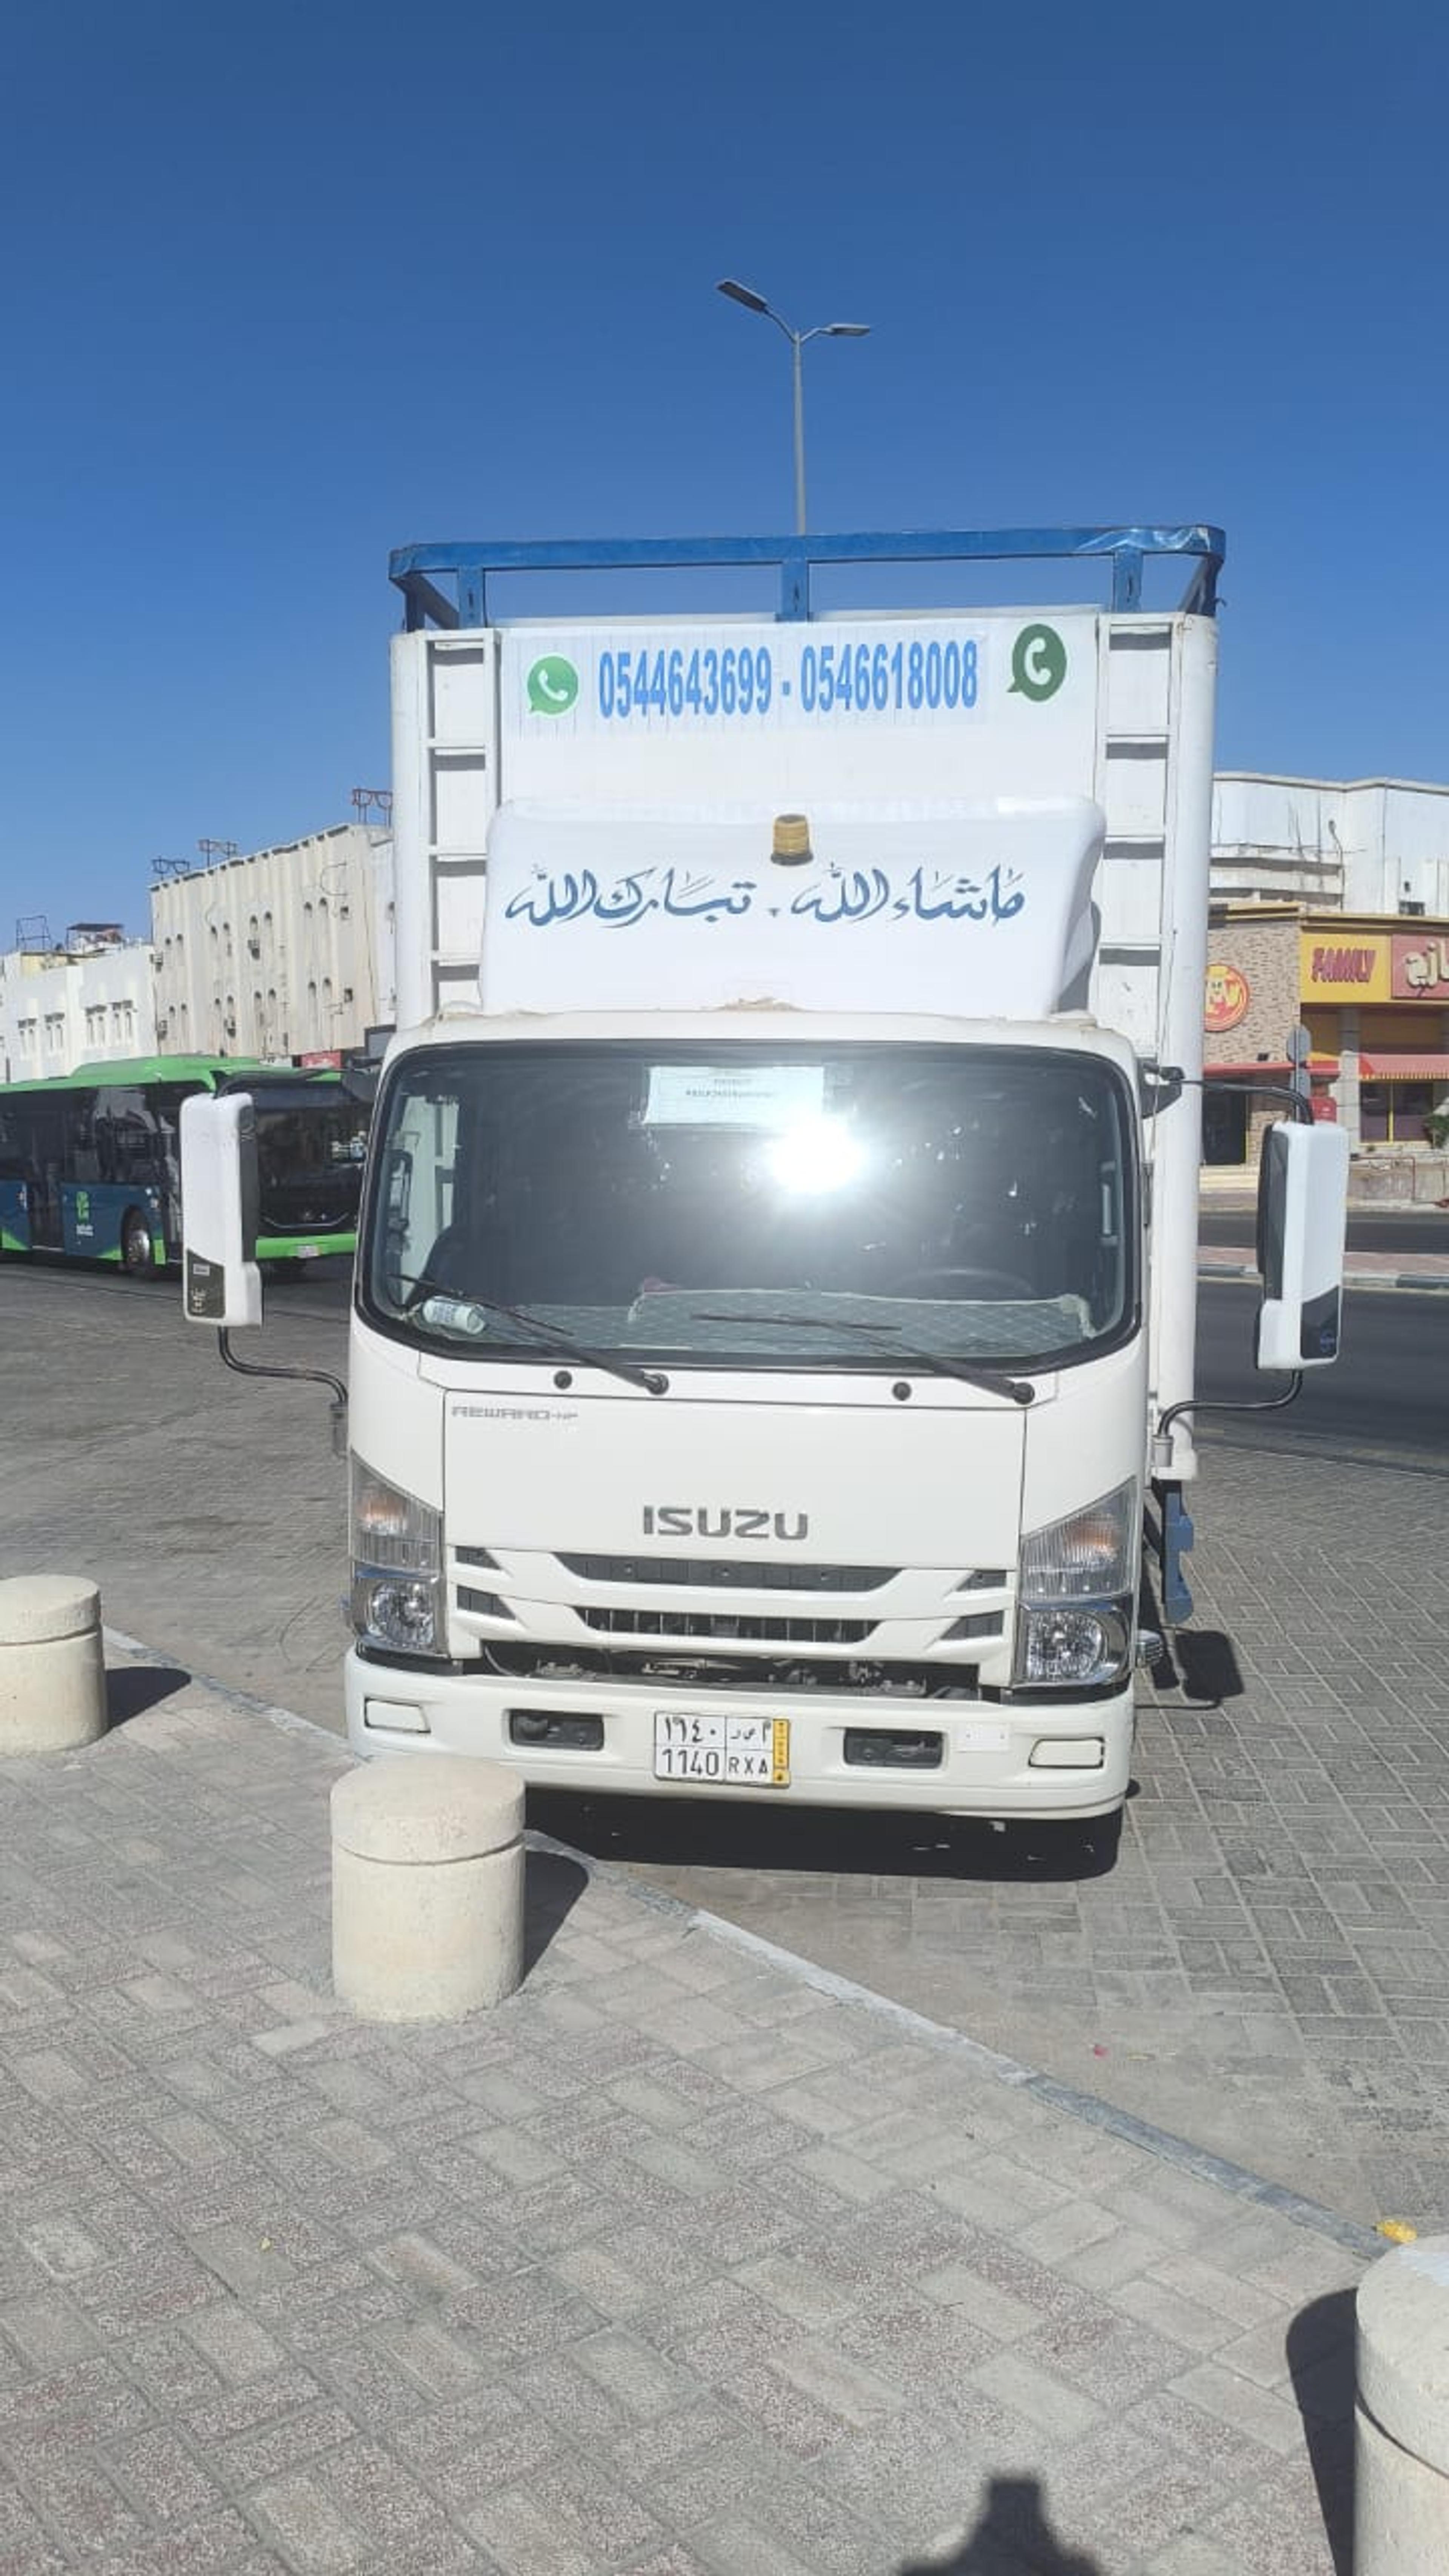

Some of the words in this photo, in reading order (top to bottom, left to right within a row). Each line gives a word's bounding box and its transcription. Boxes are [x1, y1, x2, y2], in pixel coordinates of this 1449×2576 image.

[600, 646, 771, 718] 0544643699
[801, 640, 977, 712] 0546618008
[505, 864, 597, 926] الله
[594, 867, 757, 929] تبارك
[791, 858, 889, 923] الله
[1312, 947, 1377, 983] FAMILY
[643, 1506, 808, 1540] ISUZU
[662, 1748, 719, 1776] 1140
[728, 1756, 768, 1774] RXA
